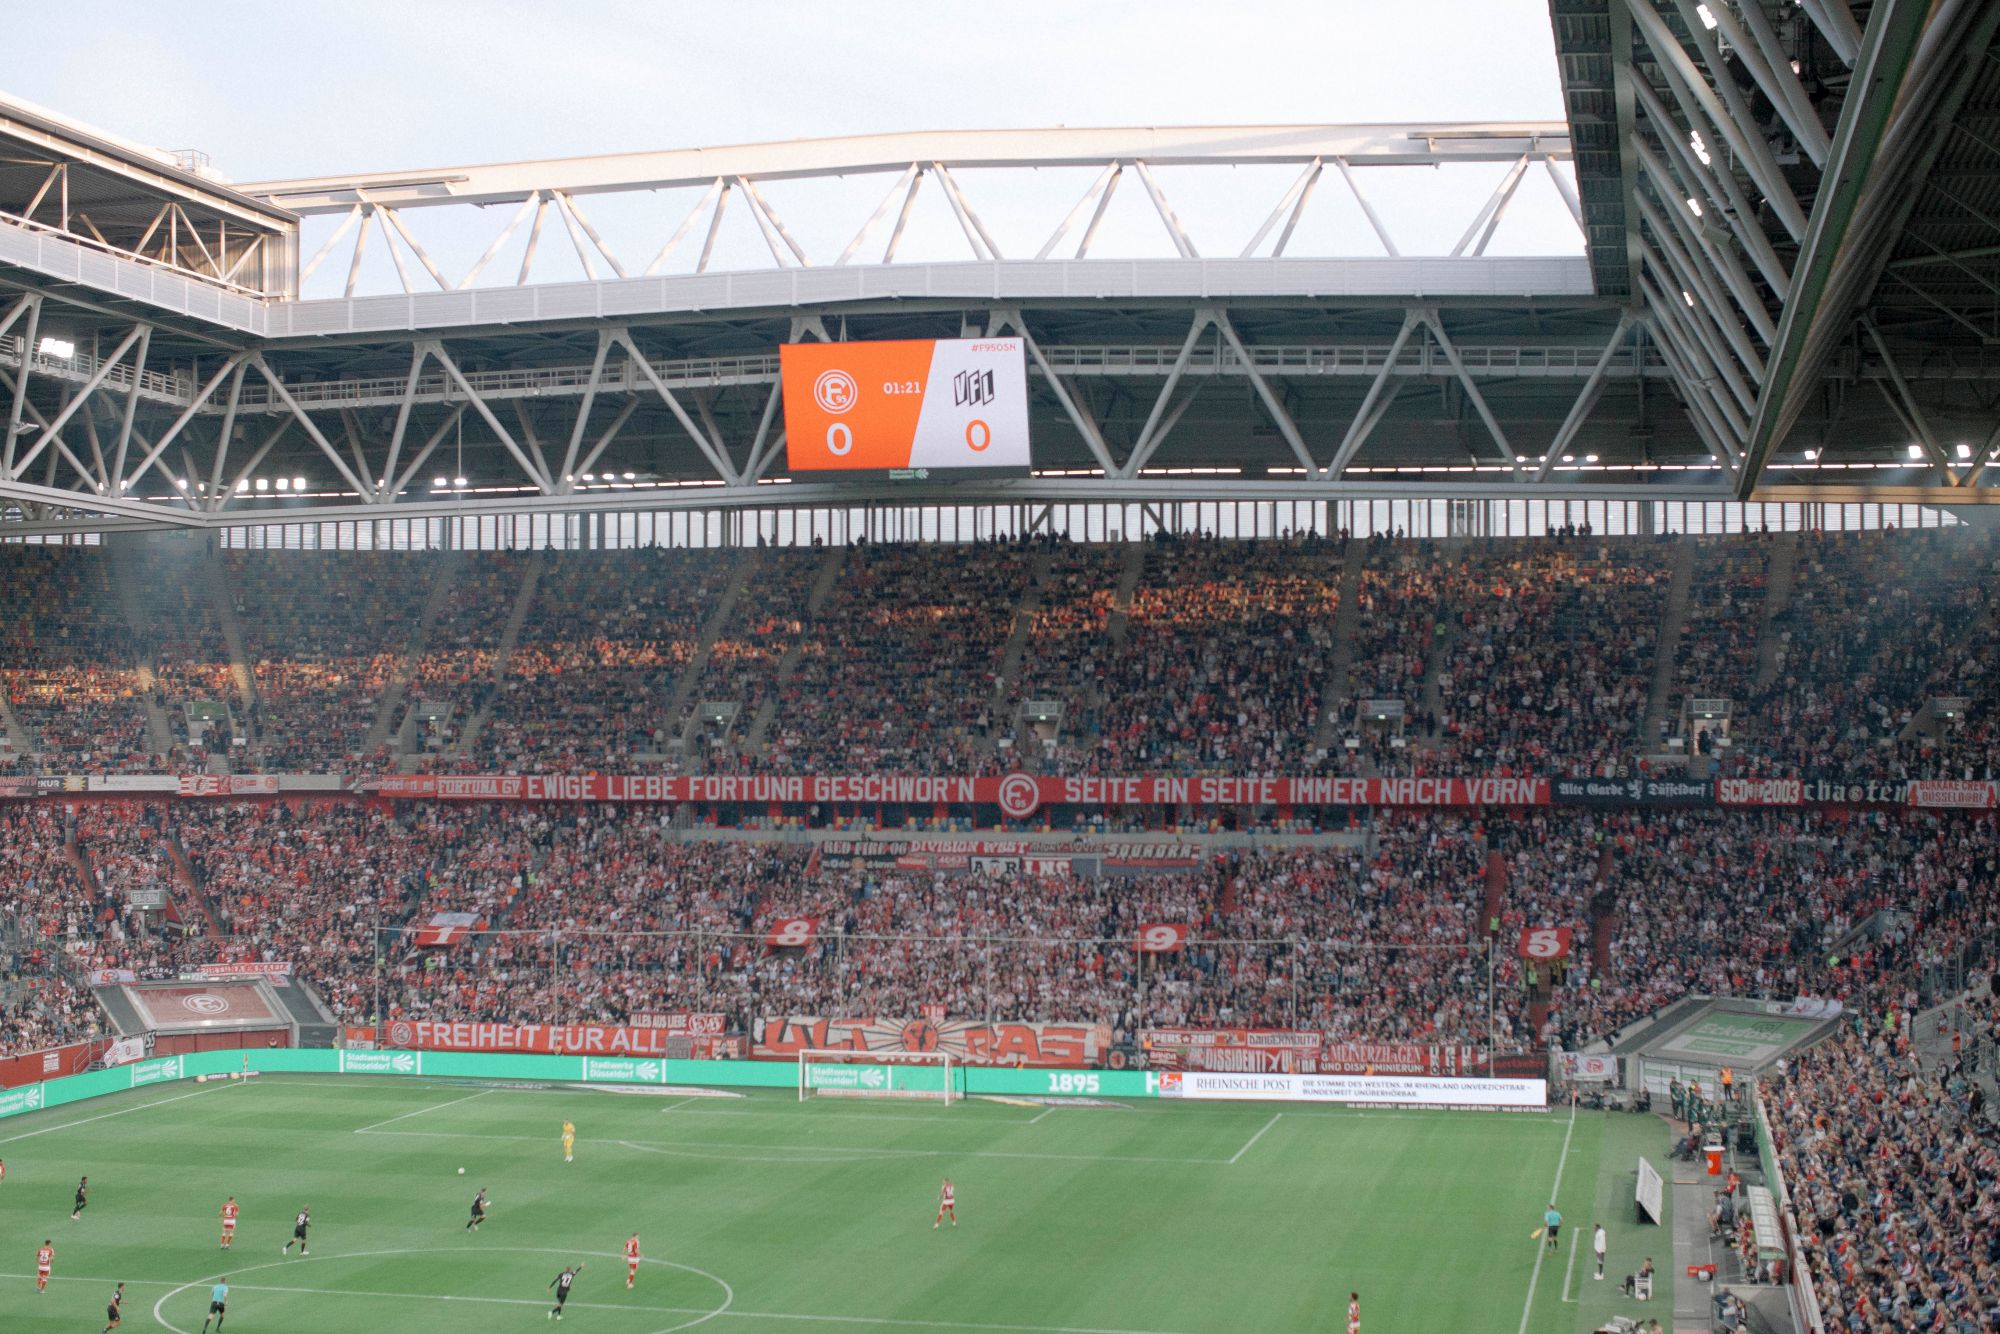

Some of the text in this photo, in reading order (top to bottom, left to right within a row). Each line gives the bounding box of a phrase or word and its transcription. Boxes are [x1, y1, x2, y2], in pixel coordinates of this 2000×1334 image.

[883, 381, 921, 395] 01:21
[826, 422, 853, 456] 0
[965, 419, 991, 452] 0
[438, 780, 497, 795] FORTUNA
[527, 776, 597, 800] EWIGE
[607, 776, 678, 800] LIEBE
[689, 776, 804, 801] FORTUNA
[1065, 778, 1141, 803] SEITE
[1153, 778, 1189, 803] AN
[1200, 778, 1278, 804] SEITE
[1289, 778, 1368, 804] IMMER
[1380, 779, 1451, 804] NACH
[776, 920, 810, 946] 8
[1144, 926, 1178, 951] 9
[1527, 929, 1561, 957] 5
[416, 1022, 541, 1049] FREIHEIT
[548, 1025, 604, 1051] FÜR
[610, 1026, 684, 1053] ALL
[346, 1052, 391, 1062] Stadtwerke
[346, 1061, 390, 1071] Düsseldorf
[590, 1060, 634, 1070] Stadtwerke
[812, 1066, 858, 1077] Stadtwerke
[590, 1069, 634, 1079] Düsseldorf
[812, 1075, 858, 1086] Düsseldorf
[1049, 1073, 1100, 1093] 1895
[1196, 1077, 1292, 1091] RHEINISCHE POST
[1415, 1082, 1459, 1090] RHEINLAND
[1461, 1083, 1526, 1091] UNVERZICHTBAR
